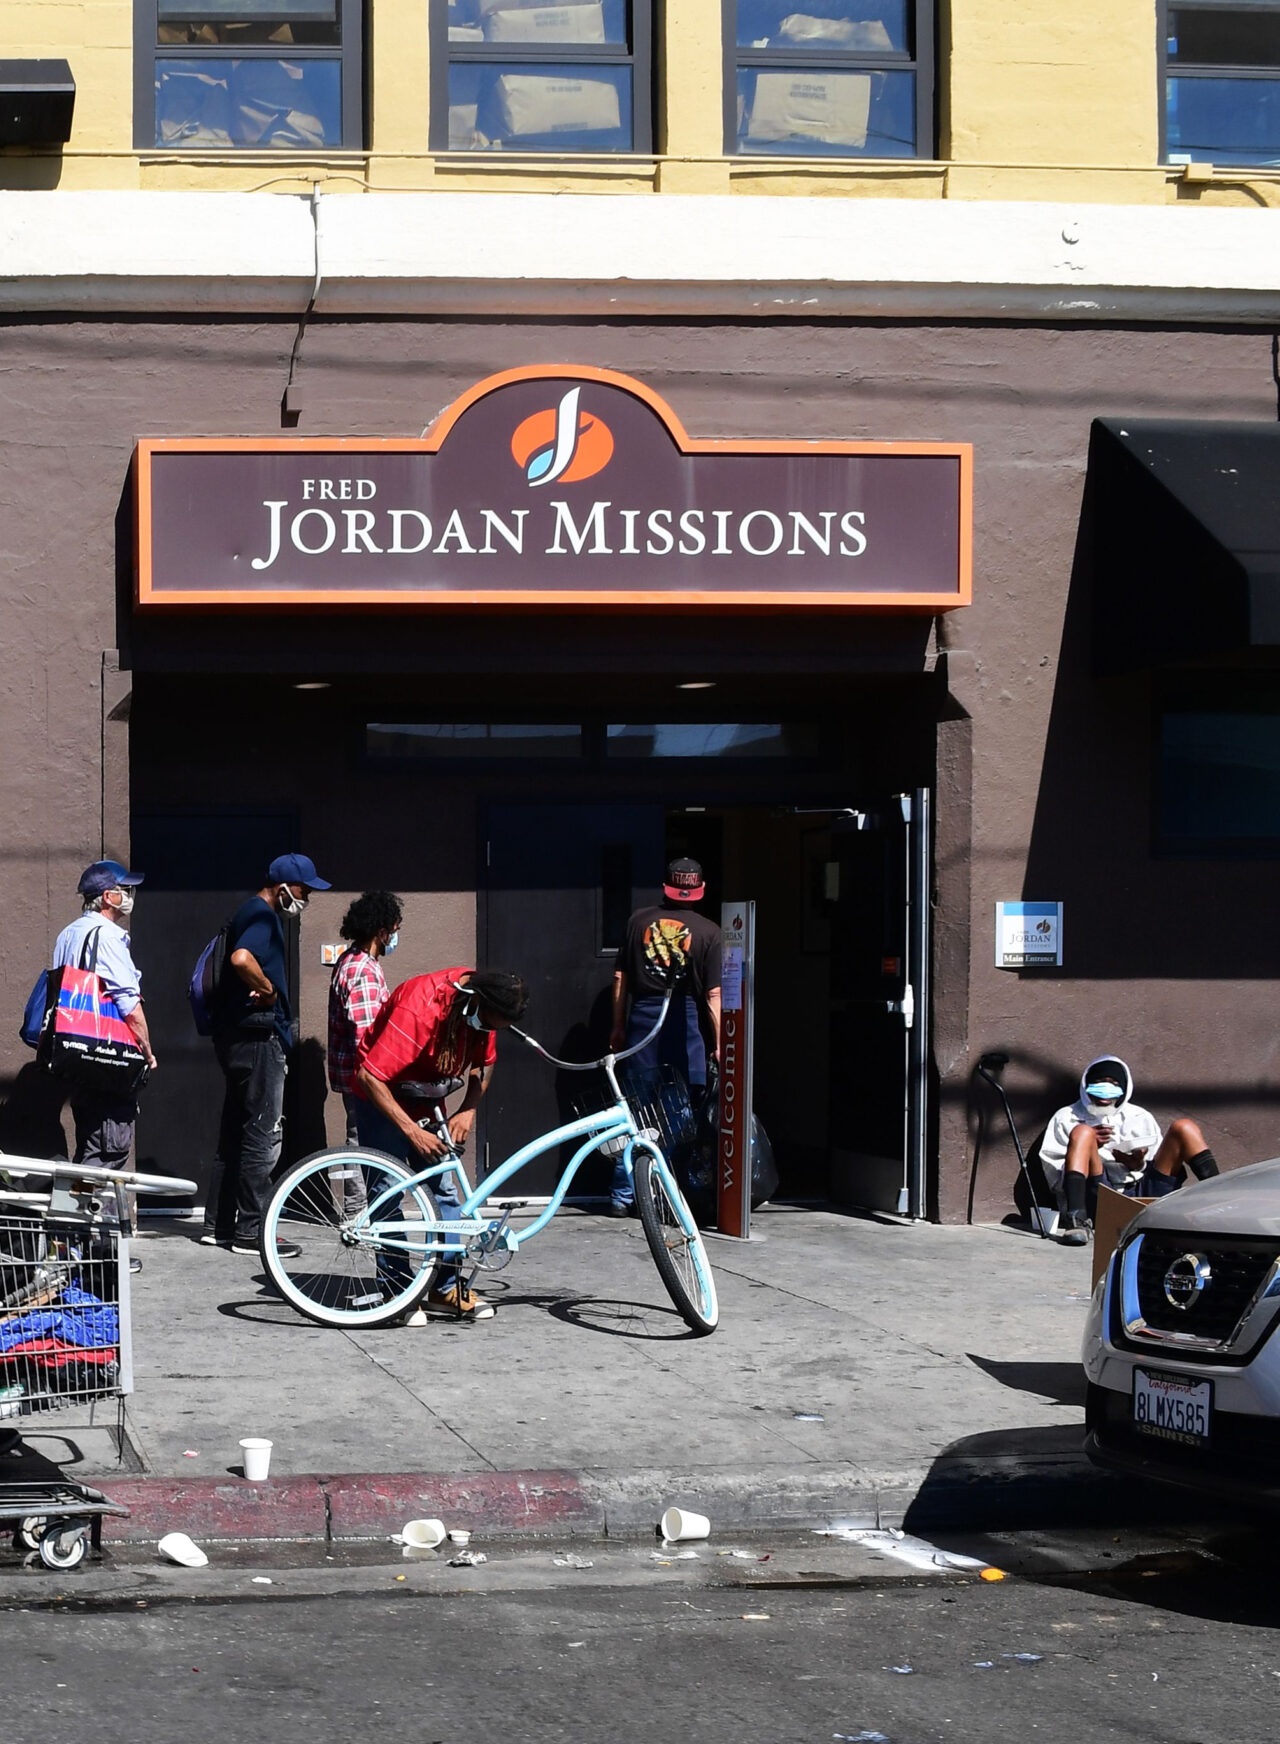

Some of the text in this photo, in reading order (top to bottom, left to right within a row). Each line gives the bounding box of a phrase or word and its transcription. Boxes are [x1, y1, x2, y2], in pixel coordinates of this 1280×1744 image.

[302, 479, 377, 500] FRED
[251, 500, 867, 570] JORDAN MISSIONS
[1009, 934, 1051, 944] JORDAN
[1004, 954, 1024, 962] Main
[1137, 1391, 1205, 1435] 8LMX585
[1142, 1424, 1195, 1445] SAINTS
